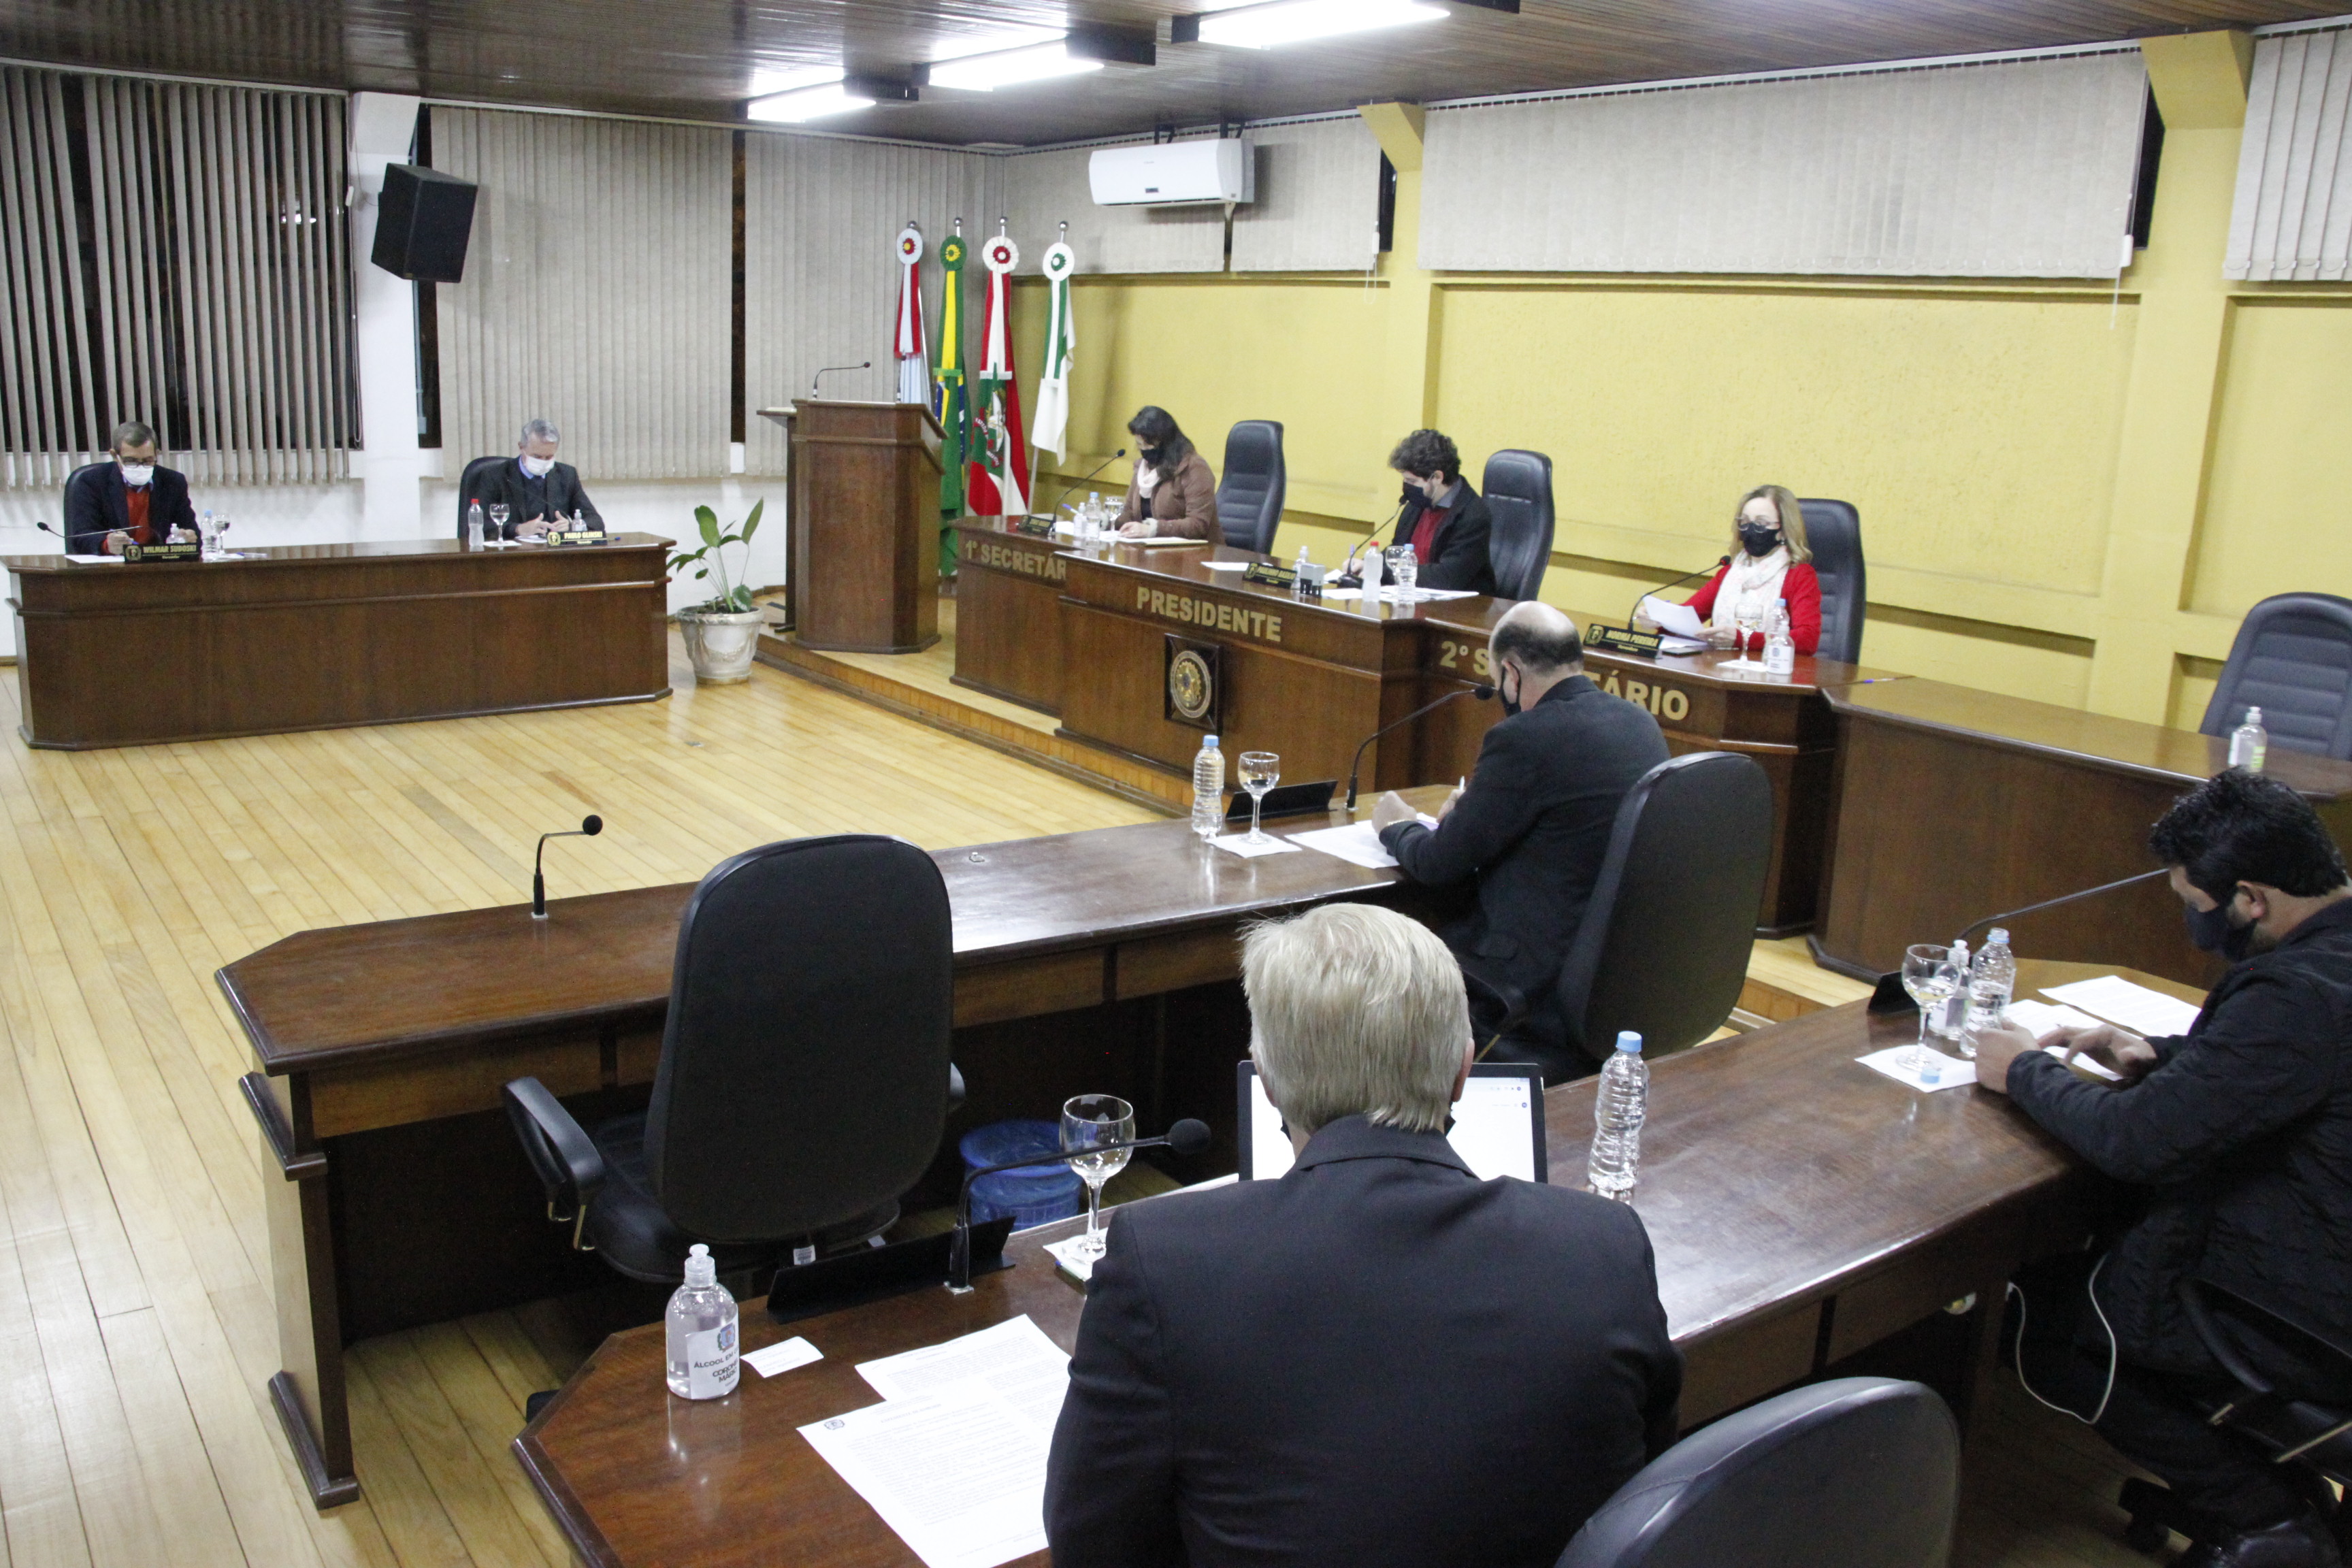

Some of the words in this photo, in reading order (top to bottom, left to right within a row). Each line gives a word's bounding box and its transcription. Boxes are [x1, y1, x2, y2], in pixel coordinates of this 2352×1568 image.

[981, 544, 1066, 580] SECRETÁR
[1137, 586, 1282, 642] PRESIDENTE
[693, 1357, 724, 1368] ÁLCOOL
